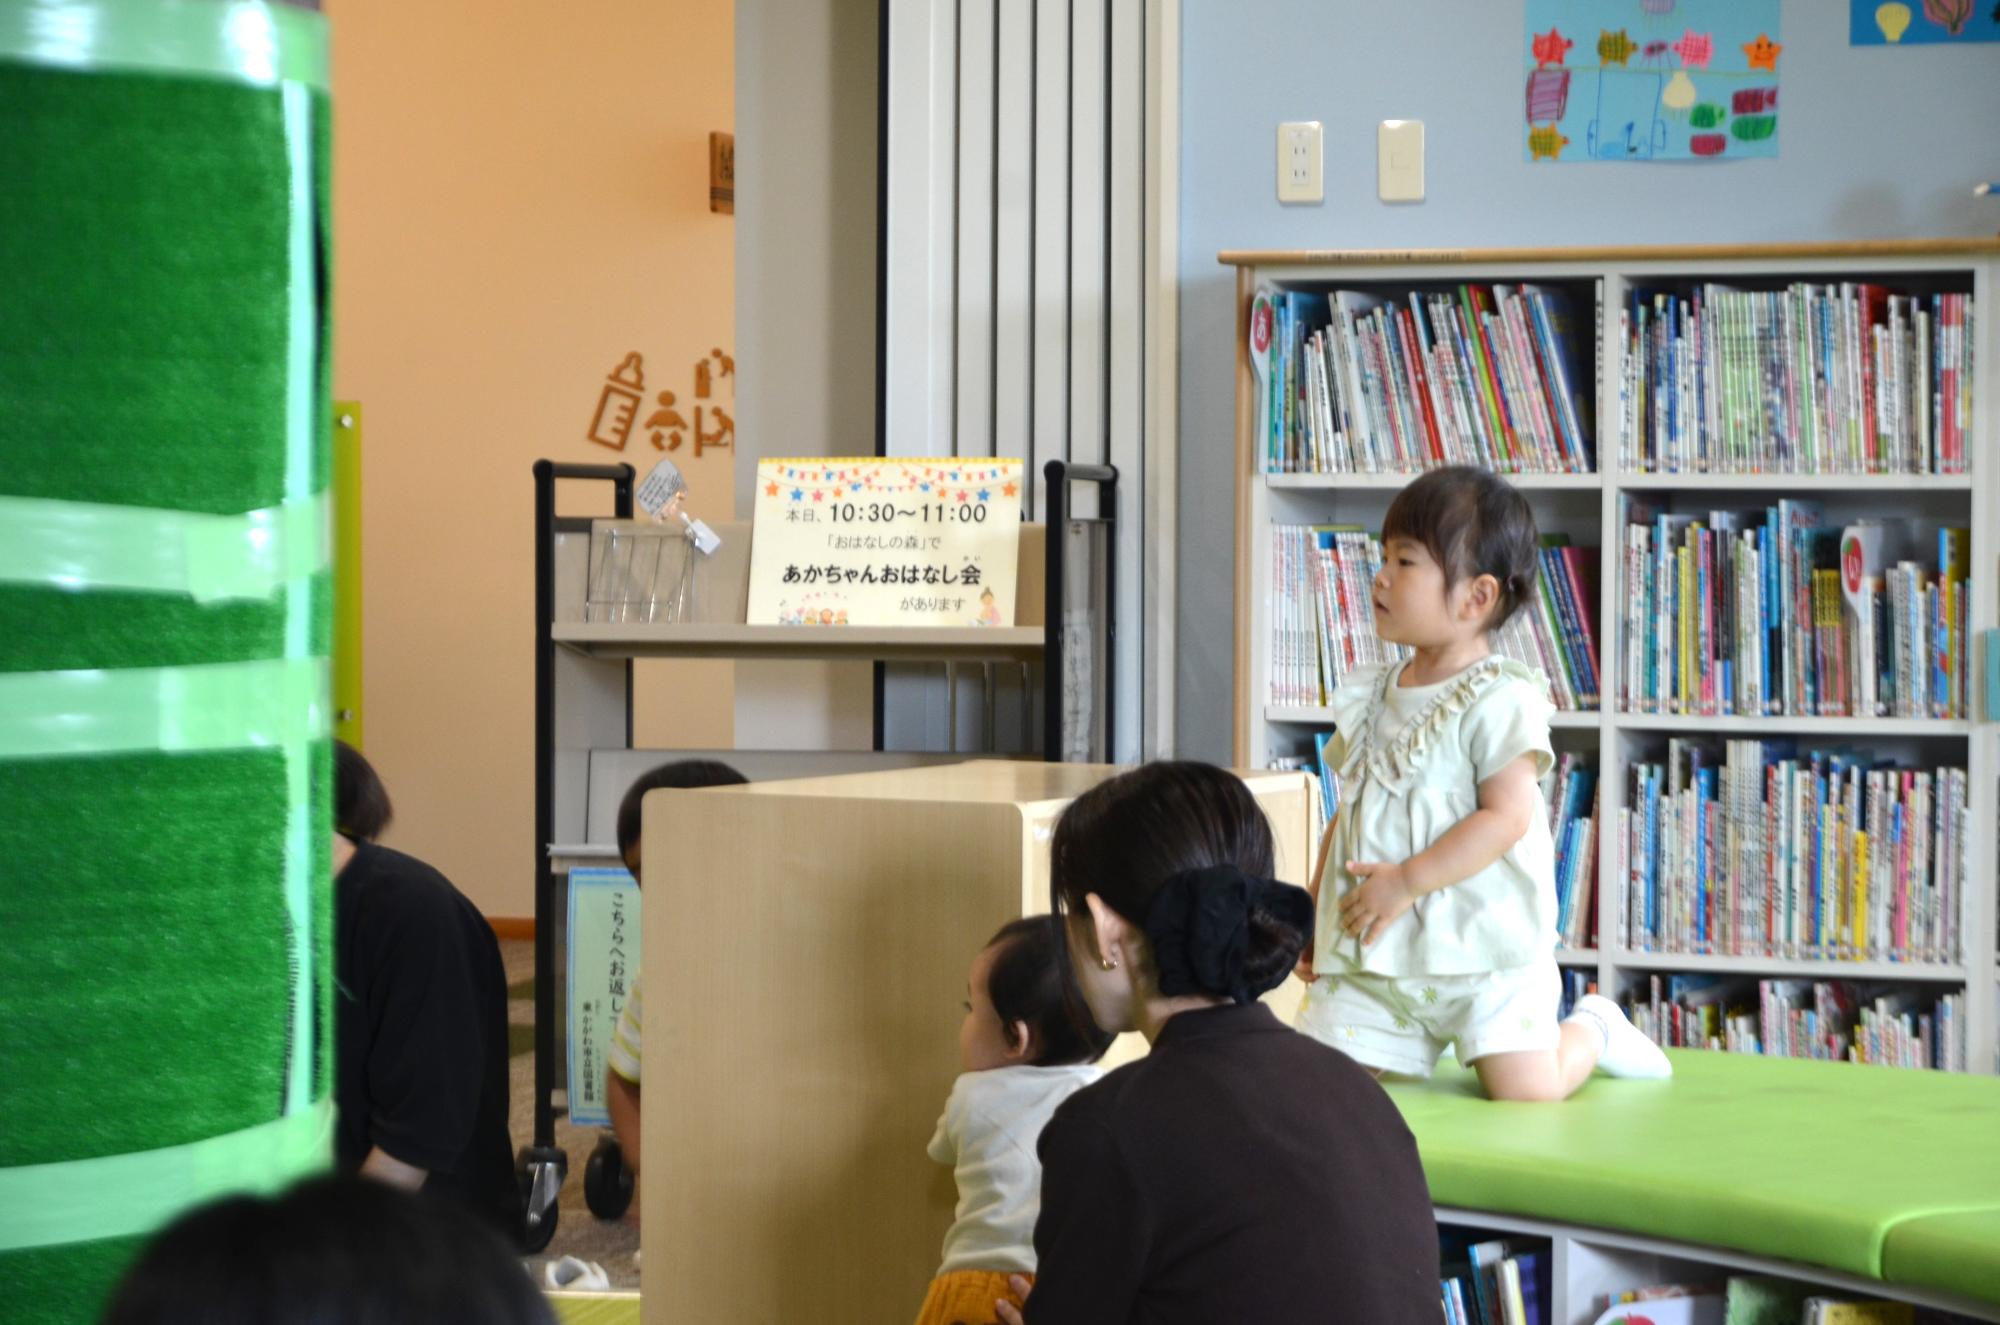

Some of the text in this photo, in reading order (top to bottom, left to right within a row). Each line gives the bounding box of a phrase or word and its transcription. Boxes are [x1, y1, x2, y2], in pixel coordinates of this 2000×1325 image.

[827, 534, 942, 550] 「おはなしの森」で
[782, 563, 982, 586] あかちゃんおはなし会
[899, 597, 966, 611] があります
